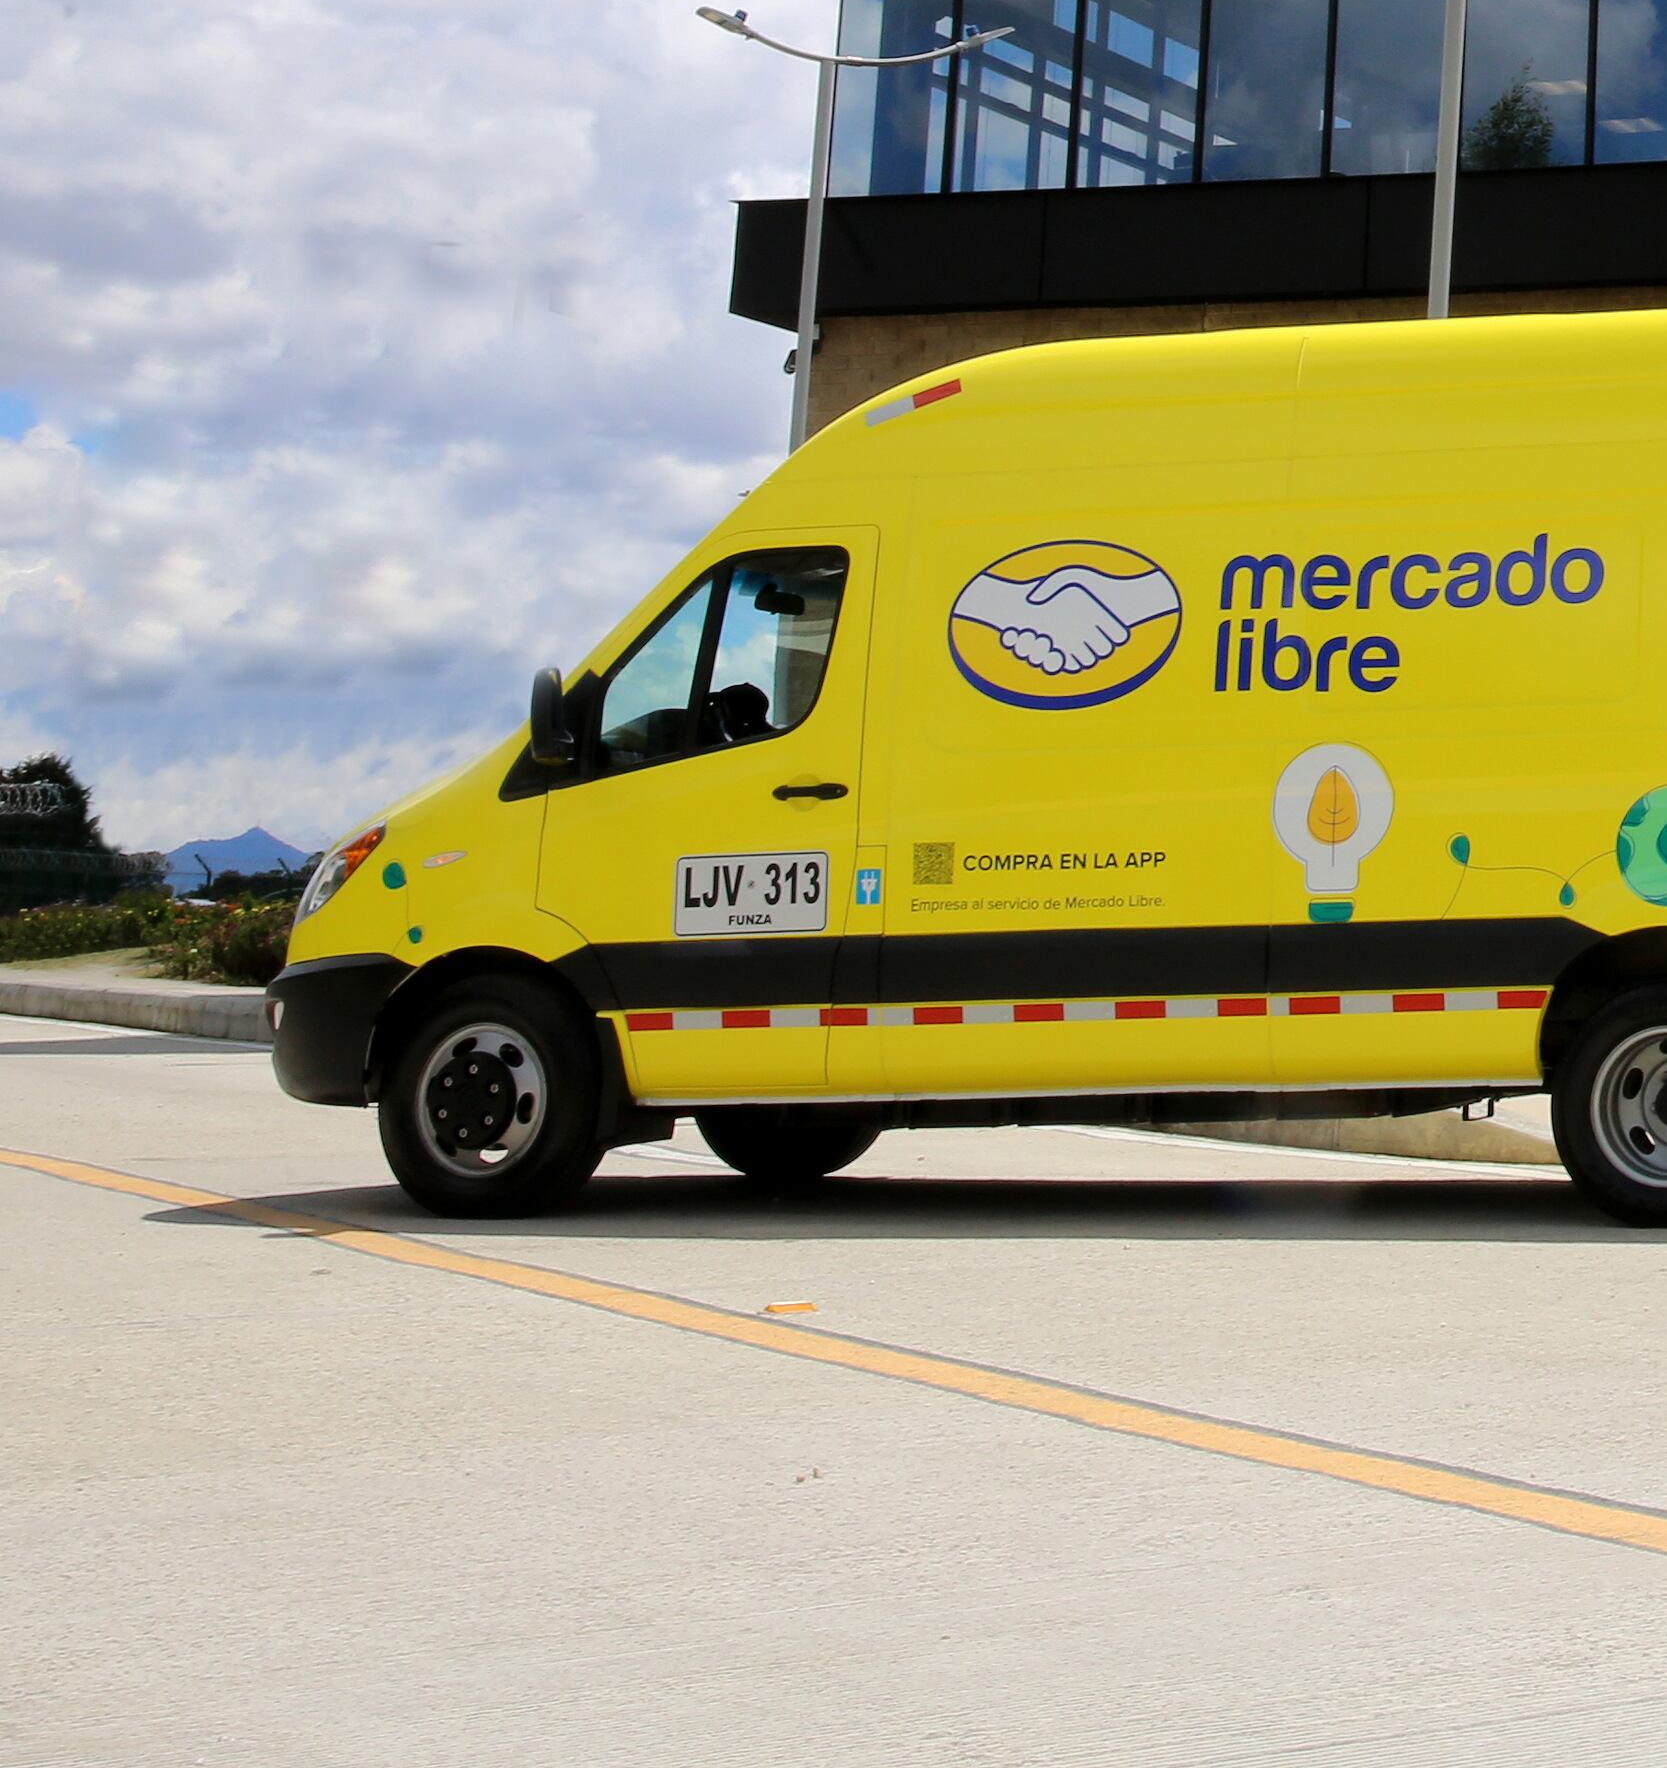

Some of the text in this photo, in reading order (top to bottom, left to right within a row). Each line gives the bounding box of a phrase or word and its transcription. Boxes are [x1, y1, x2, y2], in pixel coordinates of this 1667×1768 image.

[1219, 533, 1604, 610] mercado
[1213, 618, 1401, 692] libre
[963, 852, 1166, 871] COMPRA EN LA APP
[684, 862, 820, 908] LJV 313
[911, 894, 1165, 913] Empresa al servicio de Mercado Libre.
[728, 914, 772, 926] FUNZA
